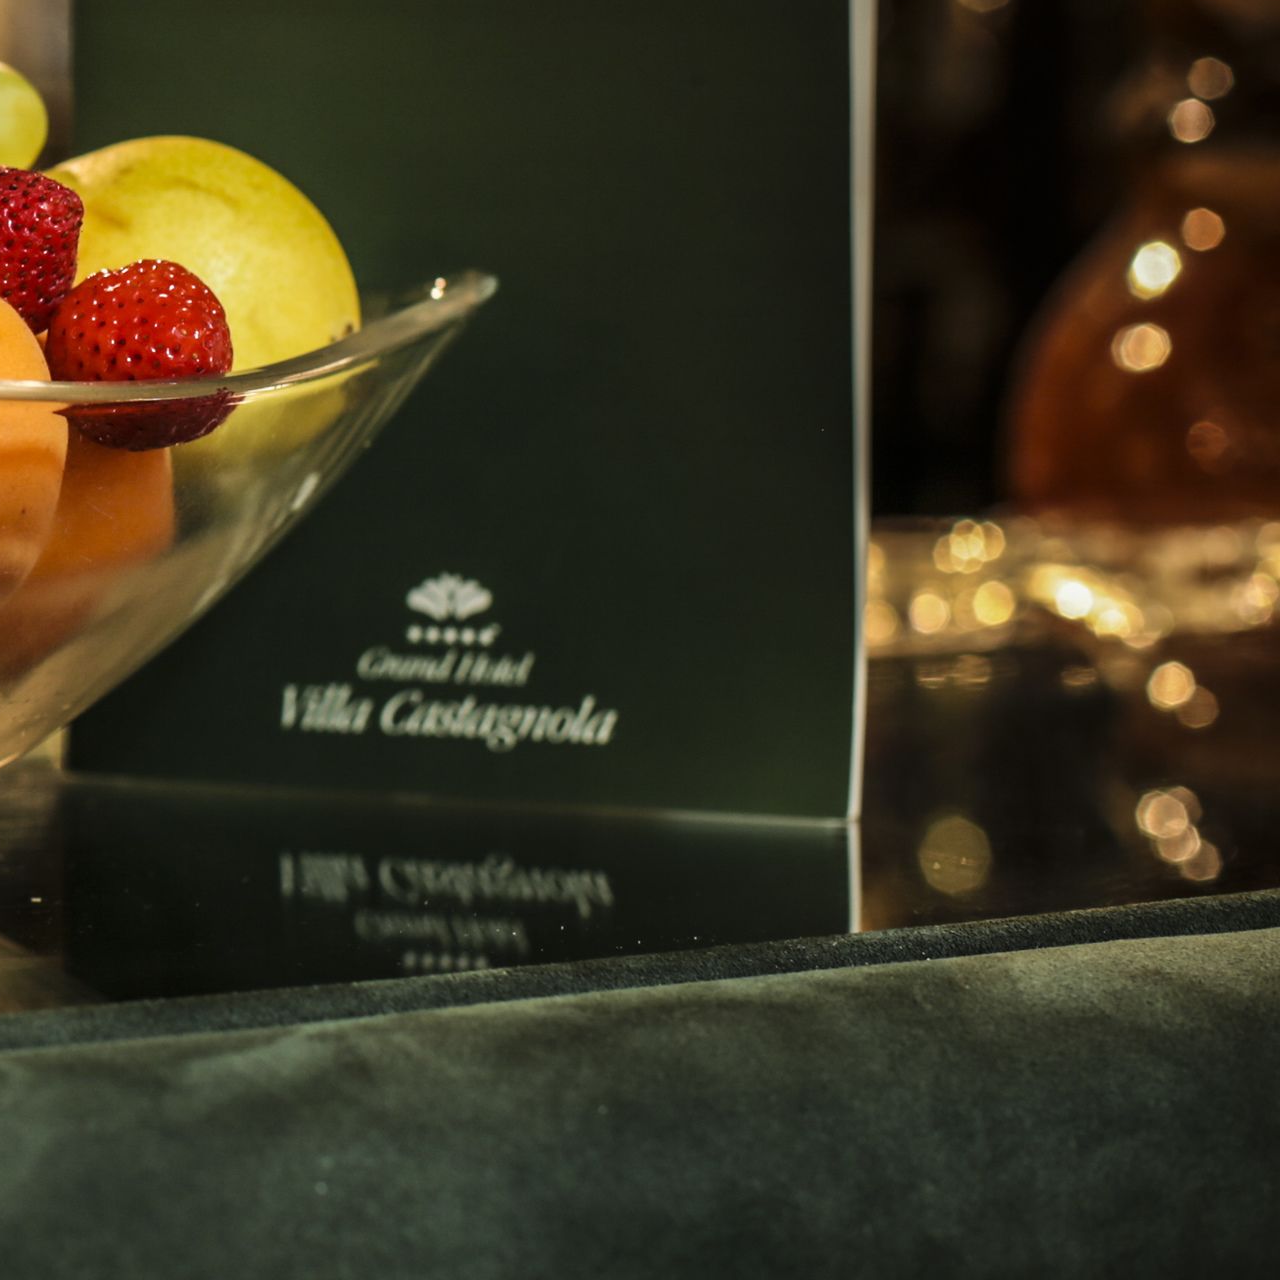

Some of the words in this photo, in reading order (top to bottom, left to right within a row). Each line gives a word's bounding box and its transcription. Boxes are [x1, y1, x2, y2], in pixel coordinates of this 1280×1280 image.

[357, 647, 458, 681] Grand
[455, 650, 535, 686] Hotel
[281, 683, 373, 734] Villa
[379, 689, 618, 753] Castagnola
